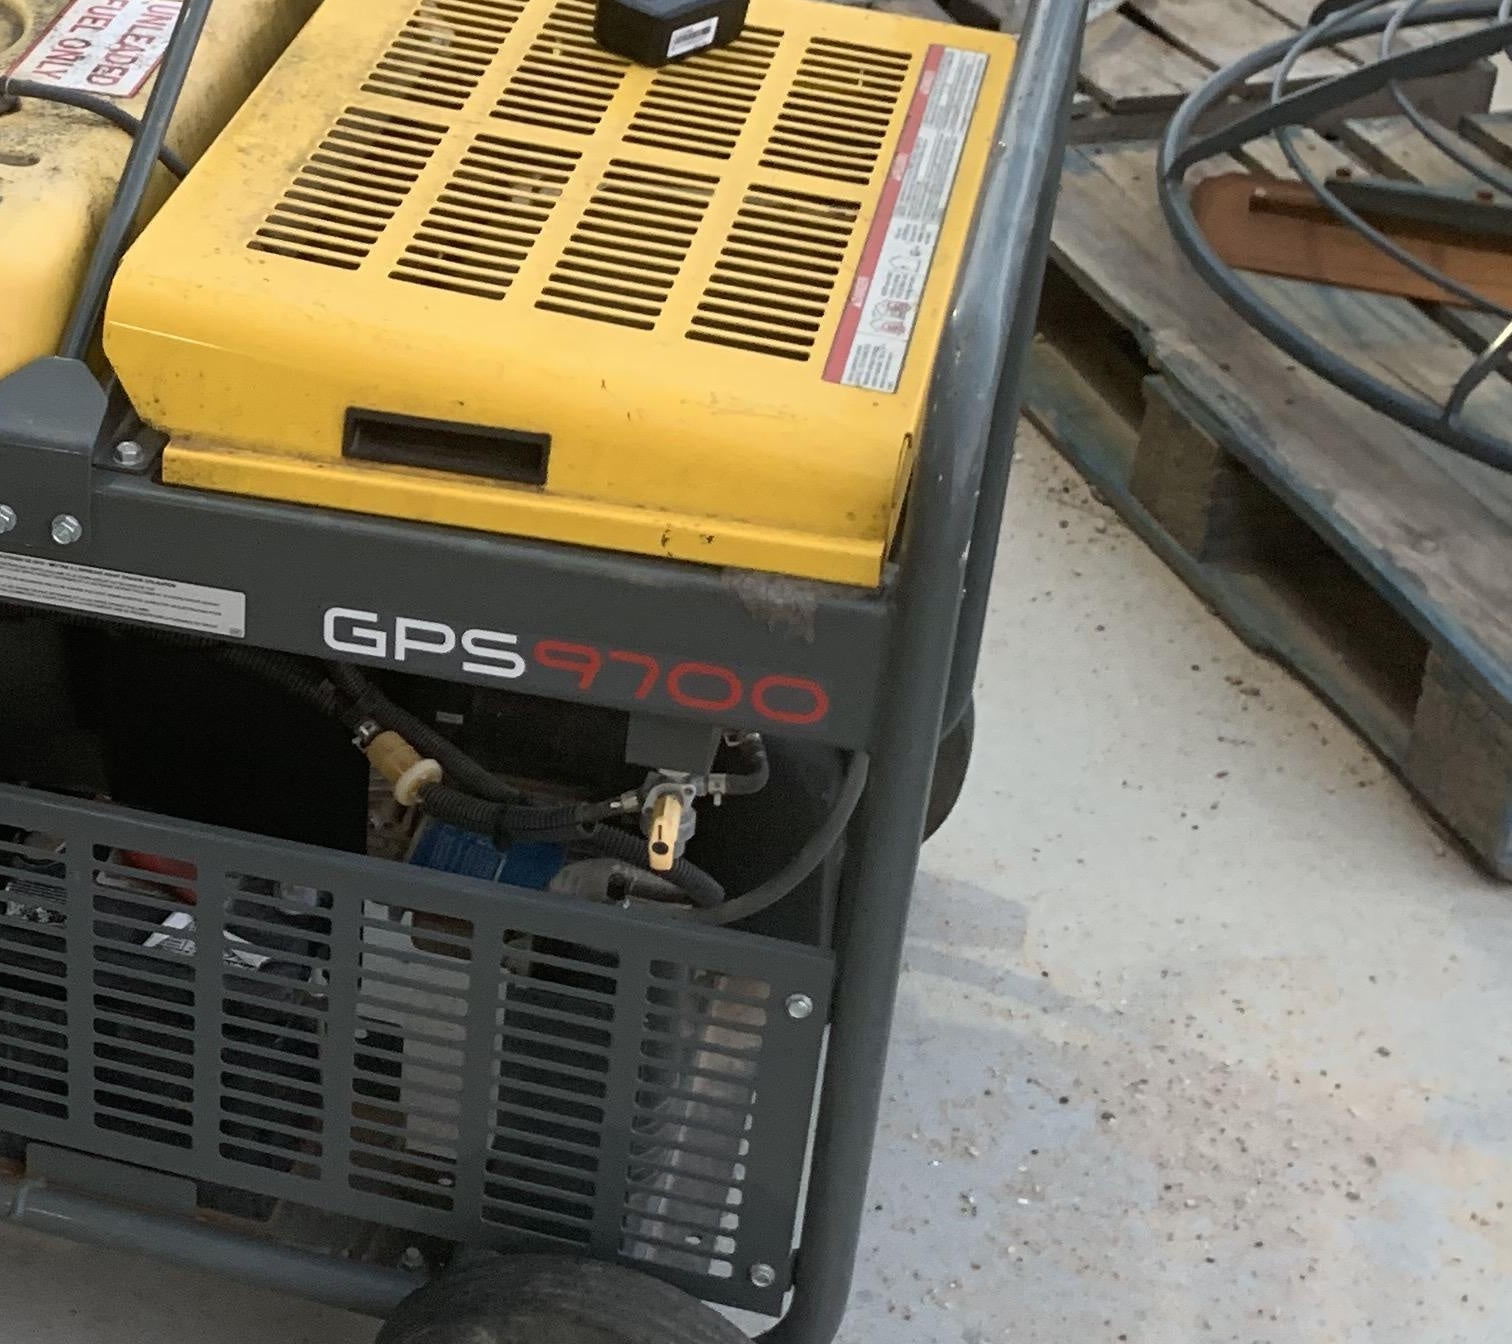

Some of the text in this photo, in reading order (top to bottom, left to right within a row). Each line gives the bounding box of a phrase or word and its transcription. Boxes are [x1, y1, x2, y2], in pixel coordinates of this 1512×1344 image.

[32, 37, 92, 81] ONLY
[87, 4, 180, 87] UNLEADED
[323, 606, 830, 725] GPS9700
